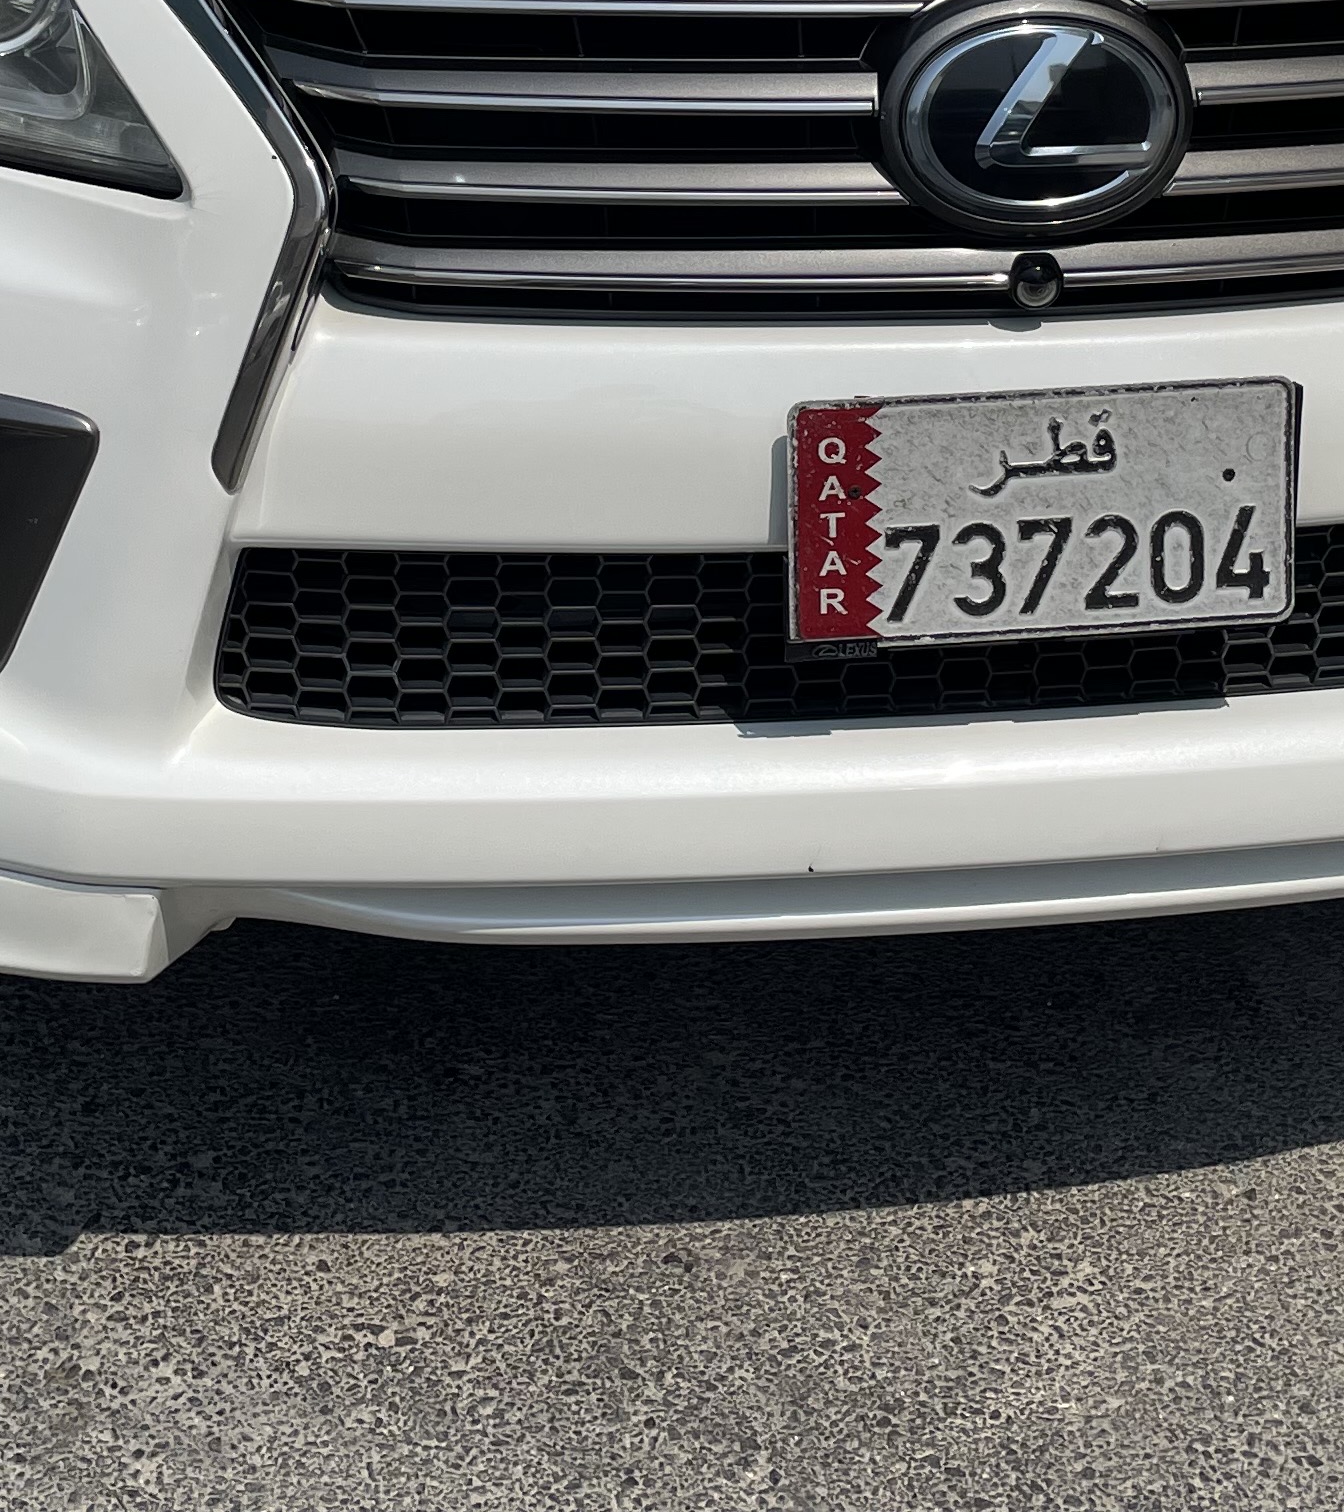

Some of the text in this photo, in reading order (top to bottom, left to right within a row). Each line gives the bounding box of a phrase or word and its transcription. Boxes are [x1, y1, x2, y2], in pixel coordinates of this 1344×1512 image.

[968, 408, 1117, 498] قطر
[816, 435, 848, 616] QATAR
[883, 504, 1271, 623] 737204
[837, 642, 878, 658] LEXUS
